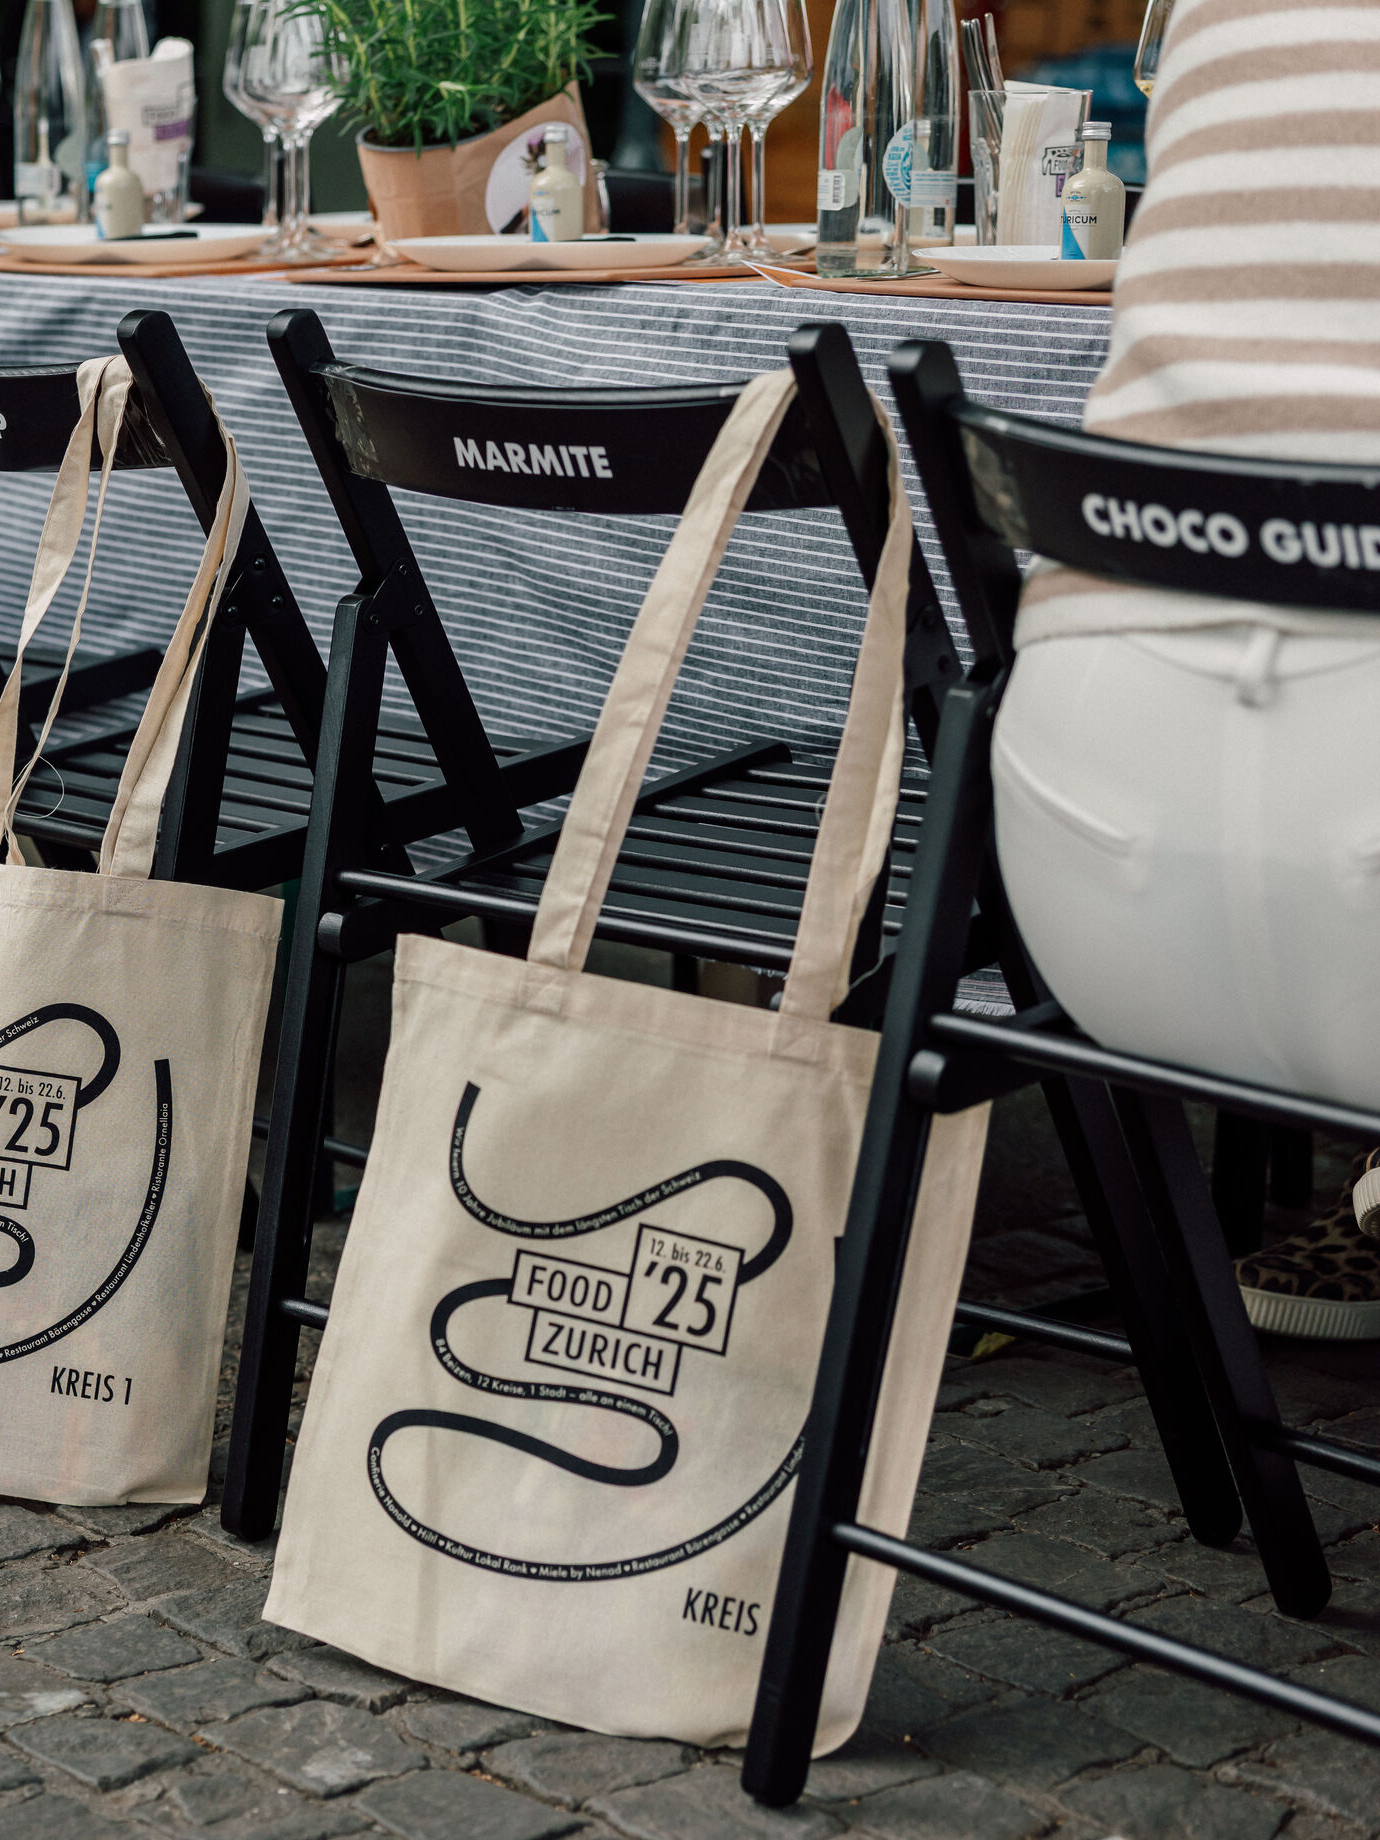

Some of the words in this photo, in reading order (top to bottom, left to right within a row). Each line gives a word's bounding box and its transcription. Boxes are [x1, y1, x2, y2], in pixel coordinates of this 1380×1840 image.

[453, 437, 613, 478] MARMITE
[1082, 493, 1249, 558] CHOCO
[5, 1016, 39, 1038] Schweiz
[0, 1076, 14, 1093] 12.
[17, 1078, 34, 1095] bis
[38, 1082, 66, 1100] 22.6.
[456, 1180, 468, 1195] 10
[552, 1223, 575, 1236] dem
[618, 1197, 644, 1215] Tisch
[644, 1189, 661, 1204] der
[661, 1171, 701, 1195] Schweiz
[4, 1334, 49, 1358] Restaurant
[48, 1305, 93, 1339] Bärengasse
[95, 1263, 129, 1302] Restaurant
[124, 1200, 157, 1264] Lindenhofkeller
[151, 1148, 166, 1192] Ristorante
[159, 1103, 169, 1145] Ornellaia
[6, 1221, 30, 1244] Tisch!
[650, 1238, 667, 1259] 12.
[672, 1243, 690, 1263] bis
[695, 1250, 726, 1273] 22.6.
[527, 1265, 613, 1312] FOOD
[644, 1261, 723, 1337] '25
[542, 1322, 664, 1380] ZURICH
[51, 1366, 115, 1402] KREIS
[124, 1377, 132, 1405] 1
[477, 1375, 490, 1388] 12
[492, 1381, 526, 1396] Kreise,
[540, 1385, 567, 1398] Stadt
[578, 1390, 599, 1403] alle
[600, 1396, 615, 1406] an
[616, 1399, 647, 1417] einem
[371, 1447, 386, 1498] Confiserie
[383, 1496, 413, 1529] Honold
[445, 1540, 473, 1560] Kultur
[475, 1552, 501, 1569] Lokal
[503, 1563, 527, 1575] Rank
[538, 1566, 568, 1578] Miele
[570, 1569, 584, 1580] by
[586, 1562, 622, 1577] Nenad
[631, 1547, 685, 1573] Restaurant
[682, 1587, 761, 1636] KREIS
